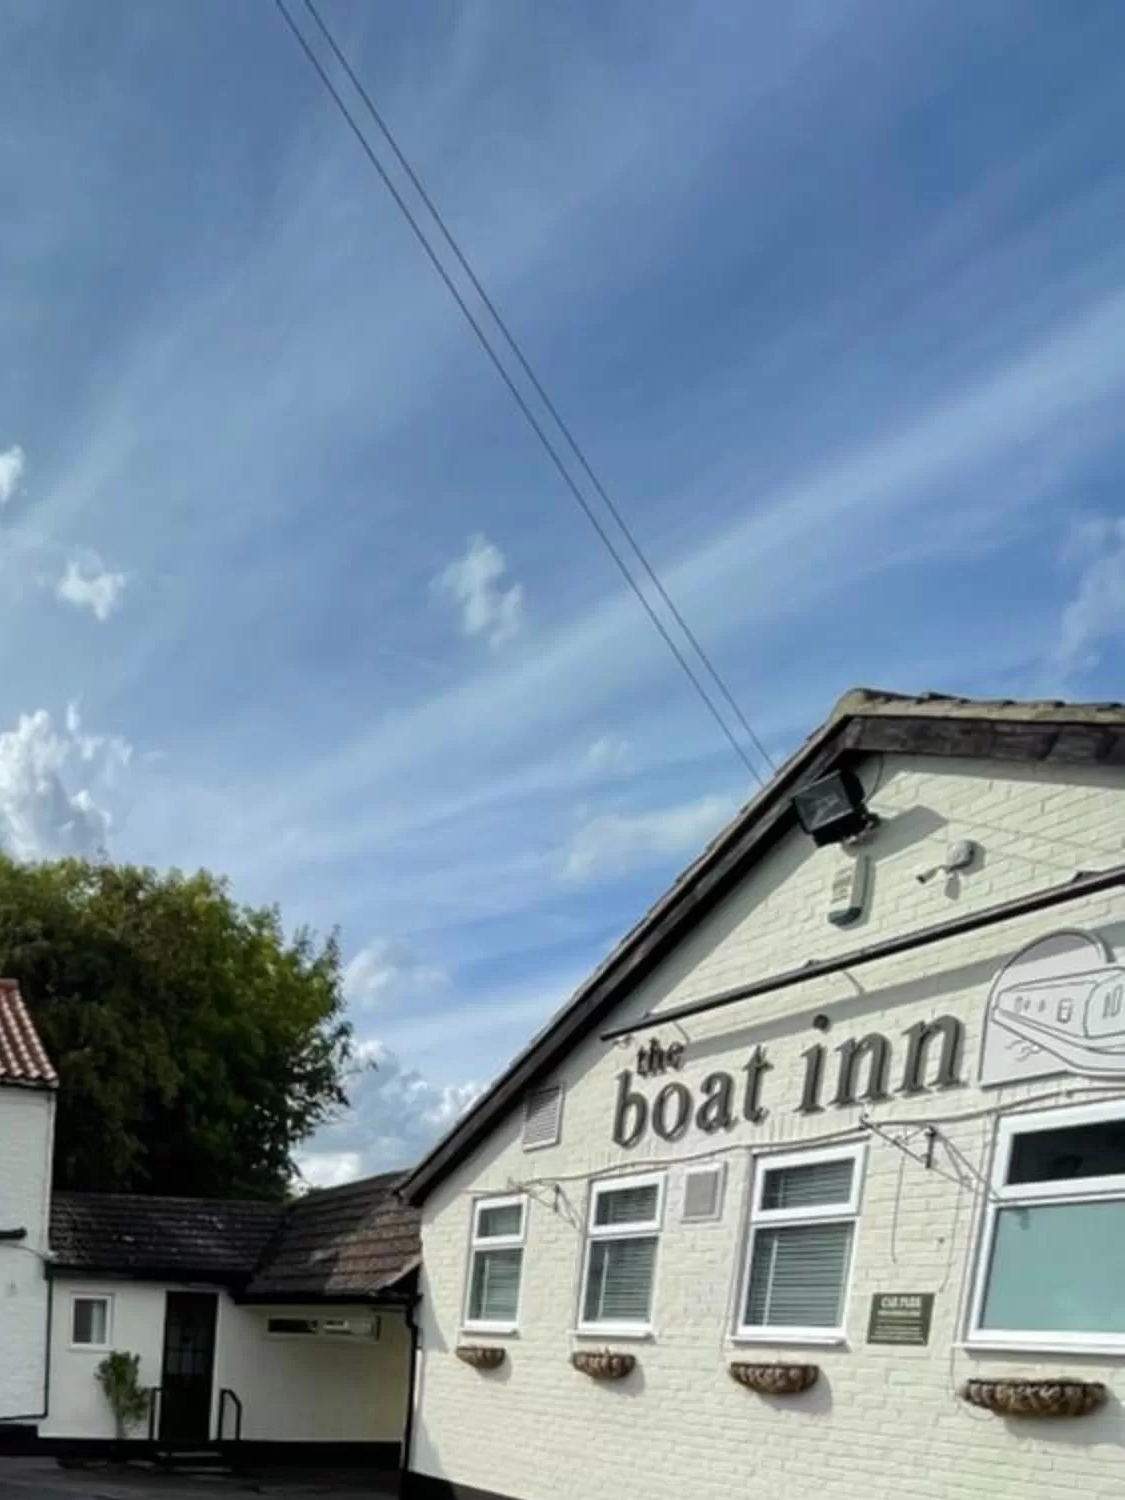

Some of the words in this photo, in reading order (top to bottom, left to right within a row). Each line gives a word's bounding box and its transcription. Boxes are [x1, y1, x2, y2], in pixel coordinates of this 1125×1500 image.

[612, 1046, 773, 1148] boat
[794, 1014, 968, 1116] inn
[636, 1037, 686, 1077] the
